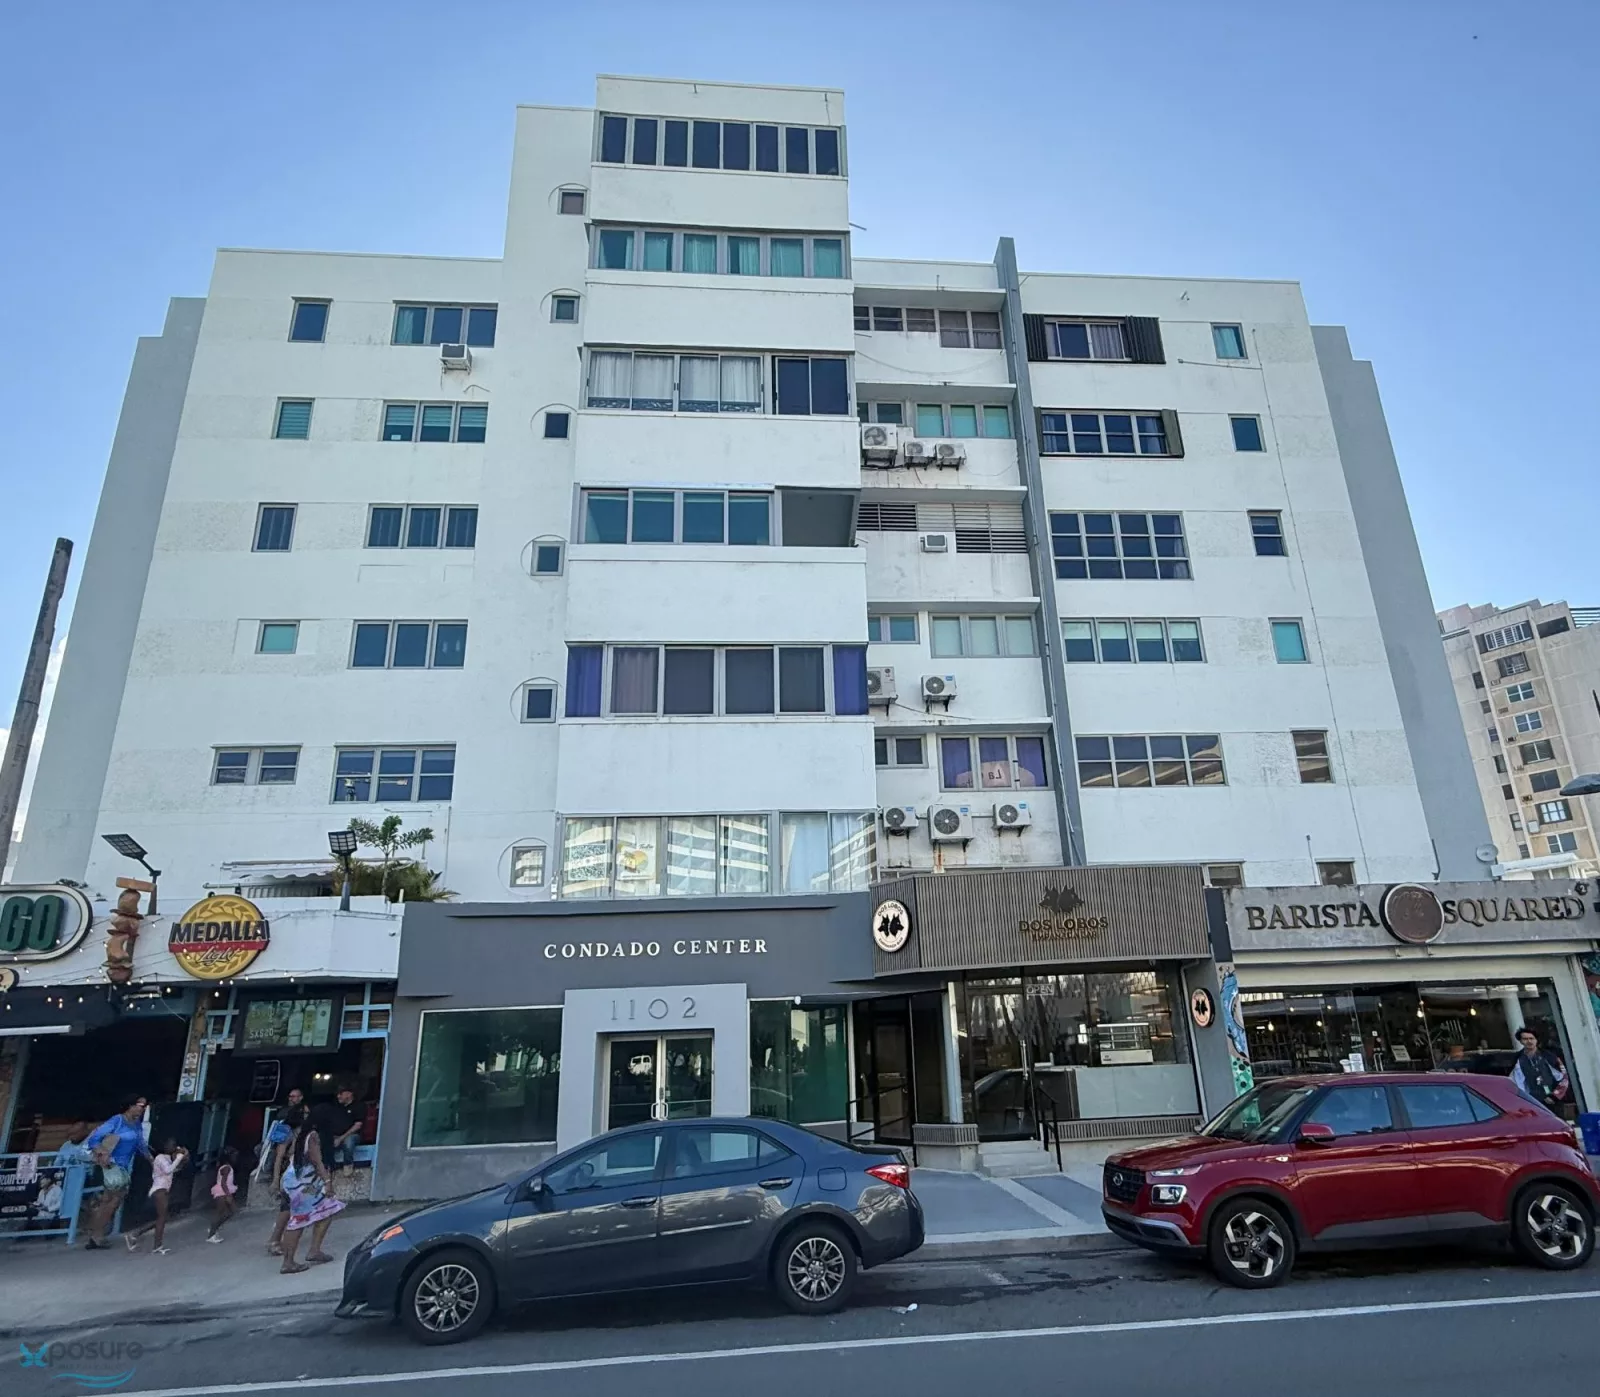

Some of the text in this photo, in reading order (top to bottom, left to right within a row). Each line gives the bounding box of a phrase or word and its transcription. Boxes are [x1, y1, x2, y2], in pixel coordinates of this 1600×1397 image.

[1245, 896, 1585, 930] BARISTA SQUARED
[170, 920, 267, 943] MEDALLA
[1019, 916, 1108, 932] DOS LOBOS
[198, 946, 241, 967] Light
[543, 939, 768, 959] CONDADO CENTER
[1026, 985, 1054, 994] OPEN
[610, 997, 698, 1021] 1102
